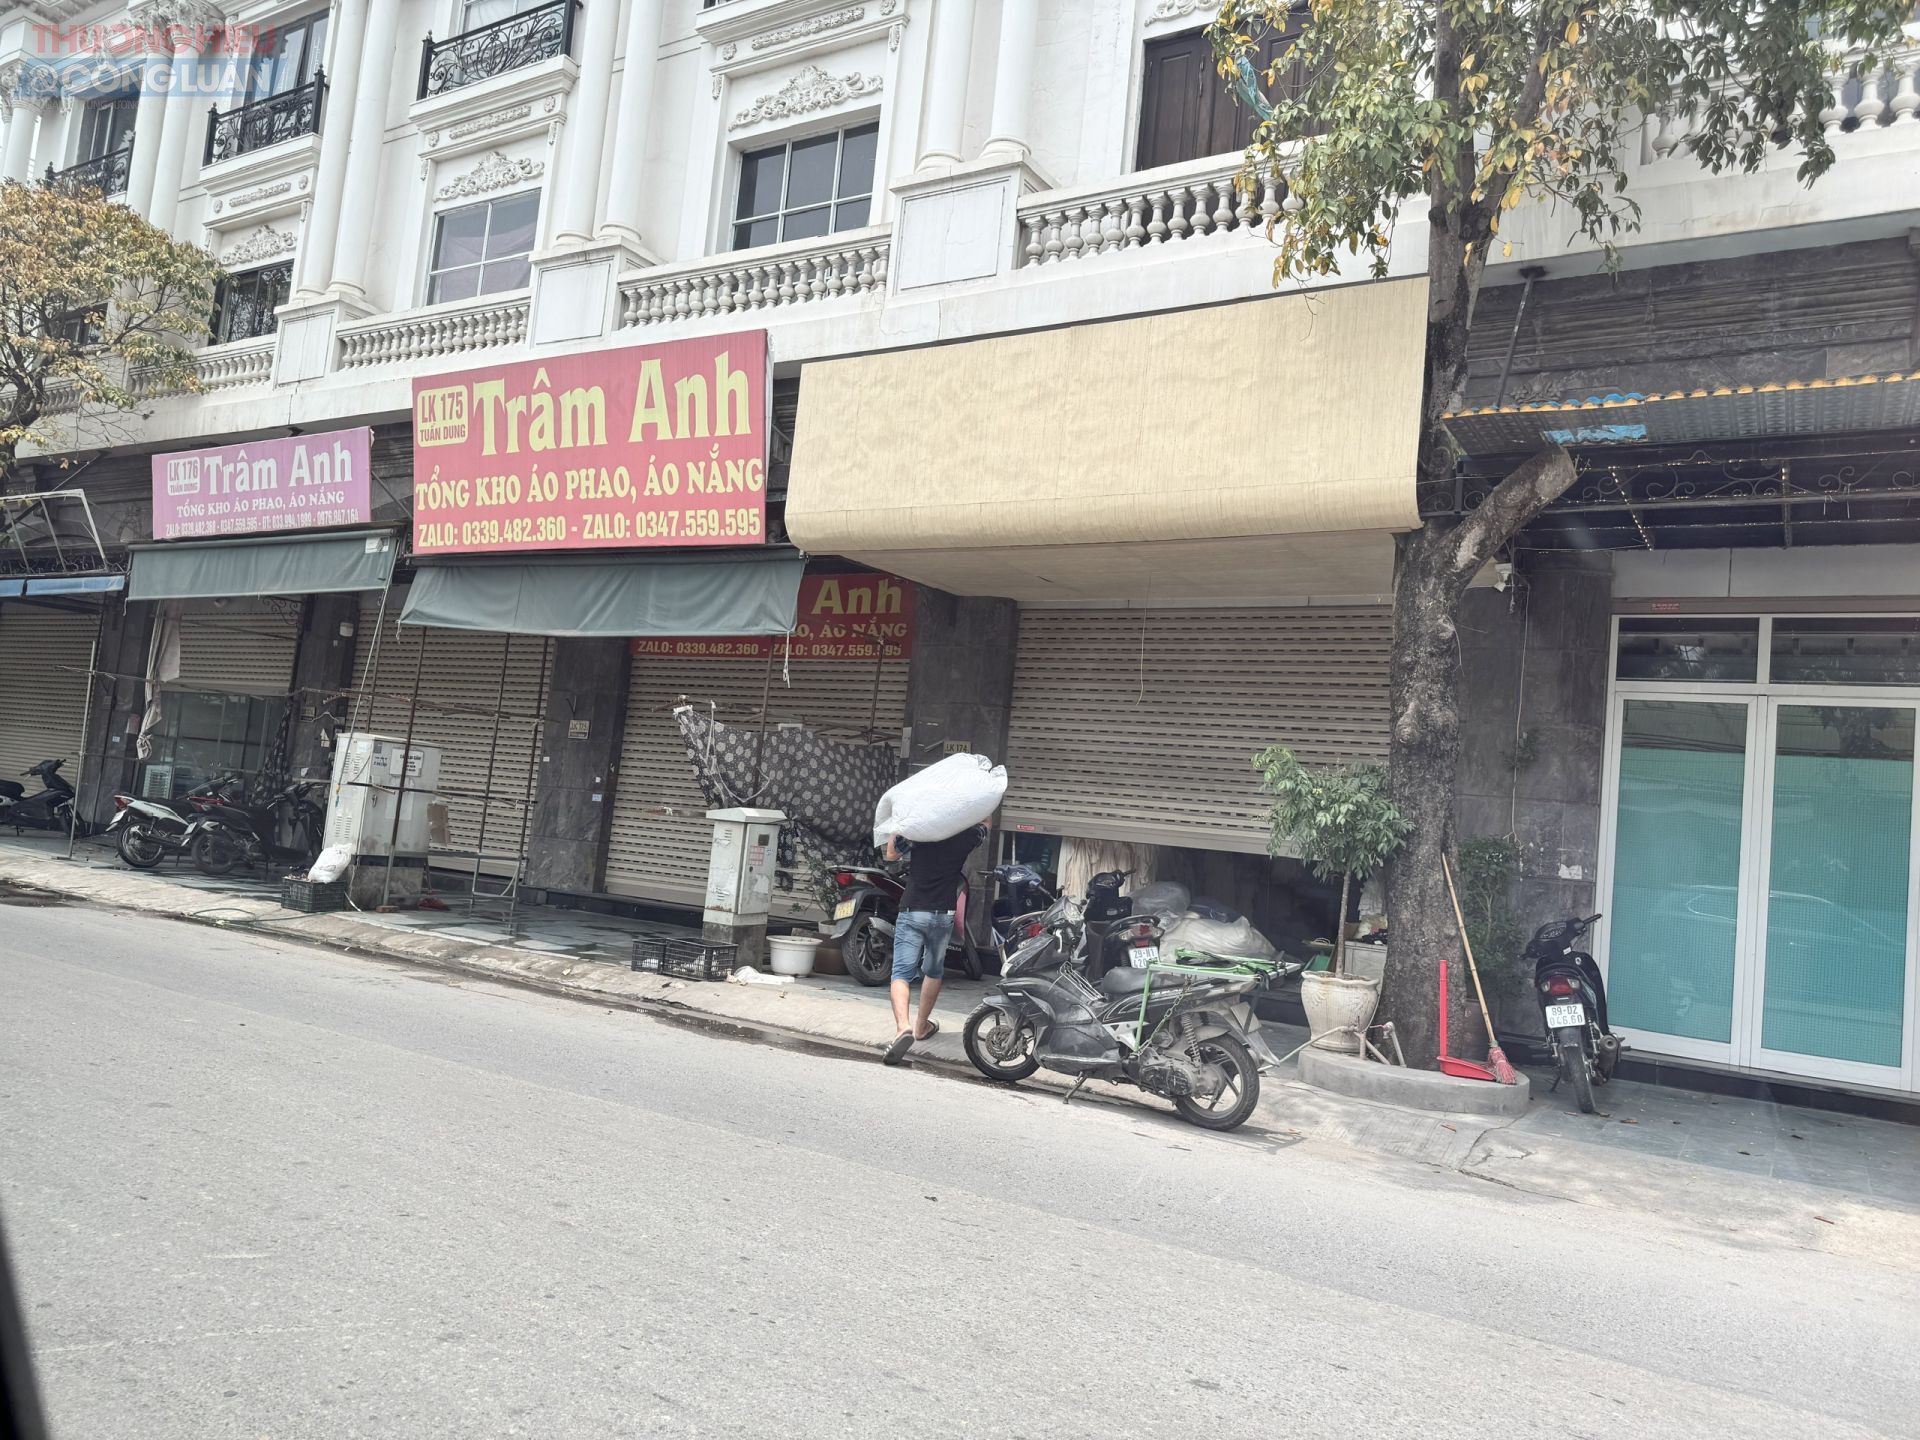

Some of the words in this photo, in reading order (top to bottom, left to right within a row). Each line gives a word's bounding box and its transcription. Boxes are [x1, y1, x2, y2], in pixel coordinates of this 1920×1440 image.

[422, 394, 436, 423] LK
[440, 391, 464, 421] 175
[473, 367, 608, 456] Trâm
[628, 351, 752, 443] Anh
[204, 449, 278, 495] Trâm
[289, 440, 352, 487] Anh
[415, 465, 470, 511] TỔNG
[475, 474, 521, 507] KHO
[527, 464, 560, 502] ÁO
[565, 465, 638, 504] PHAO,
[643, 455, 680, 496] ÁO
[686, 443, 764, 494] NẮNG
[176, 498, 205, 518] TỔNG
[208, 500, 230, 515] KHO
[233, 495, 249, 513] ÁO
[252, 496, 286, 511] PHAO,
[289, 491, 306, 508] ÁO
[309, 486, 345, 507] NẮNG
[418, 522, 459, 547] ZALO:
[462, 515, 566, 546] 0339.482.360
[582, 512, 631, 540] ZALO:
[636, 507, 761, 537] 0347.559.595
[811, 578, 903, 615] Anh
[638, 640, 673, 654] ZALO:
[676, 641, 759, 656] 0339.482.360
